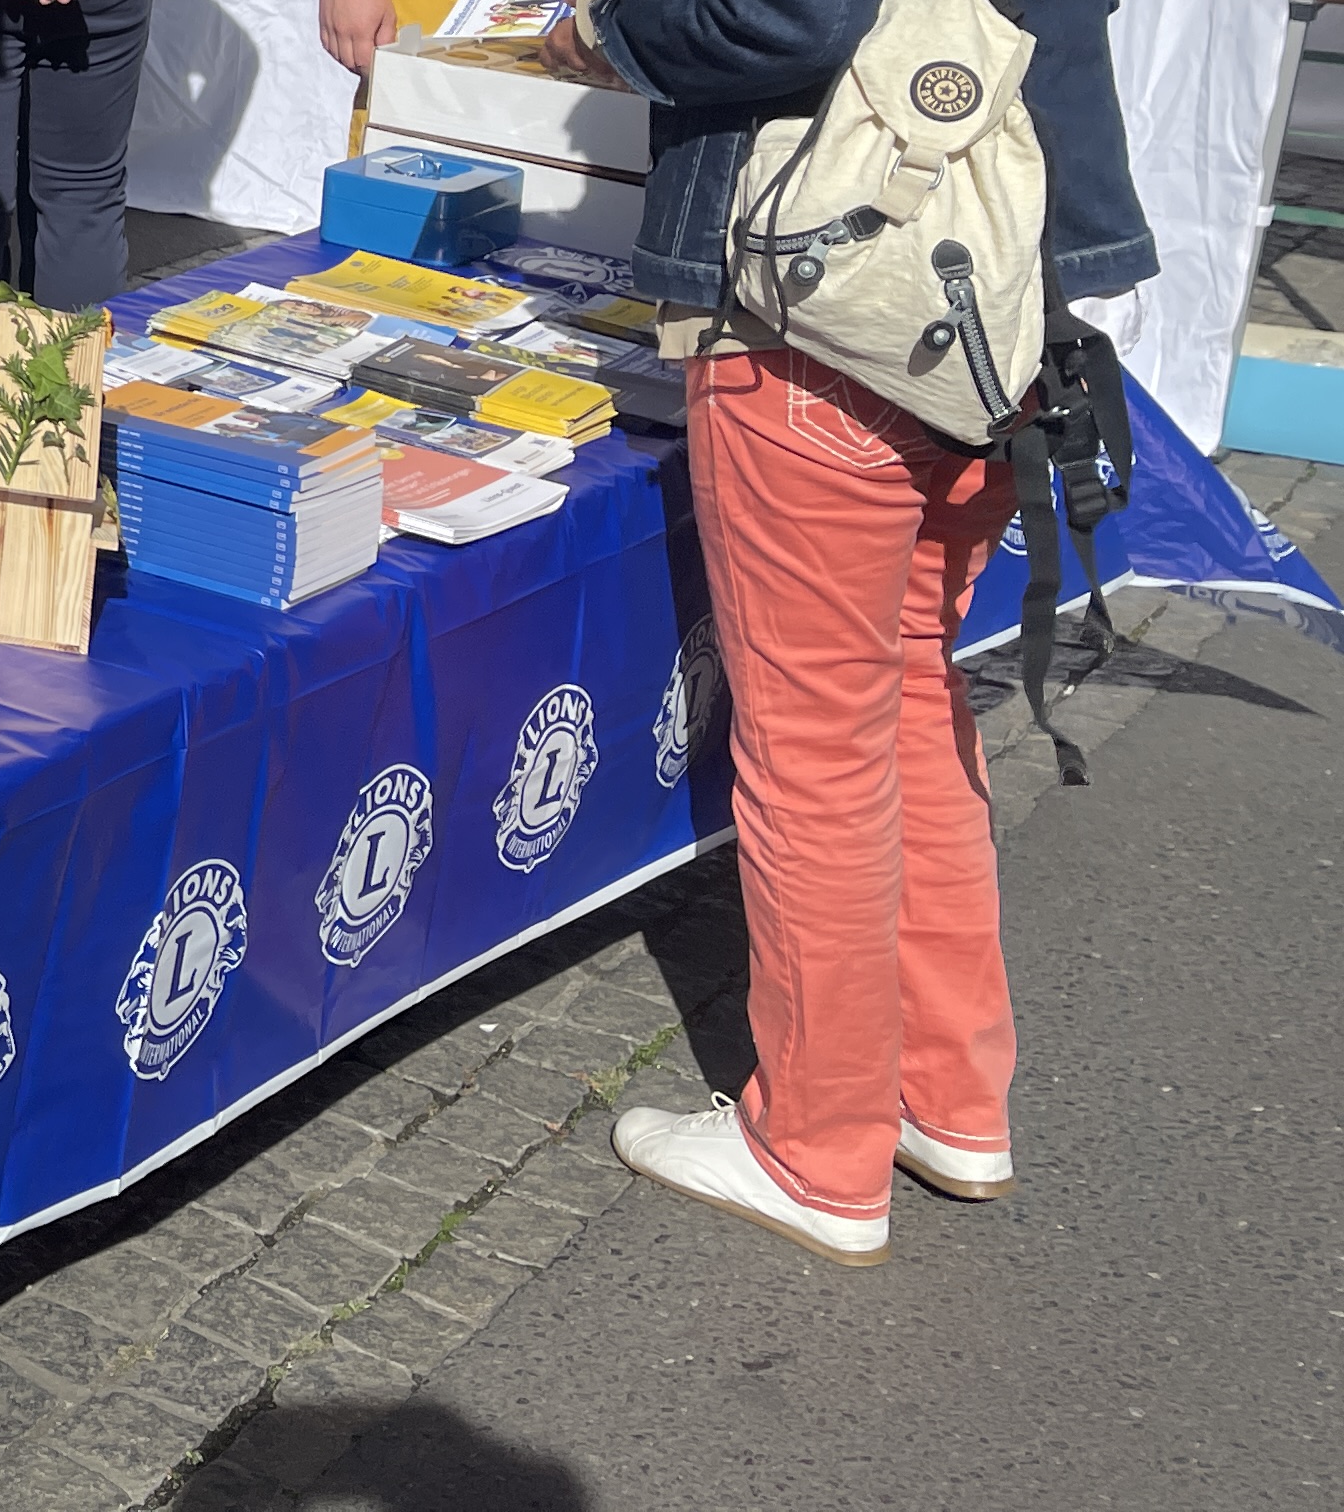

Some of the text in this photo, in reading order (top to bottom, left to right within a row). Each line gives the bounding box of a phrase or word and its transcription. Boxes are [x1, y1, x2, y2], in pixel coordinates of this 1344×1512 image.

[921, 89, 966, 113] KIPLING
[926, 69, 971, 92] KIPLING
[527, 692, 586, 745] LIONS
[354, 773, 422, 828] LIONS
[534, 748, 564, 810] L
[357, 830, 390, 900] L
[162, 868, 233, 931] LIONS
[165, 929, 198, 1007] L
